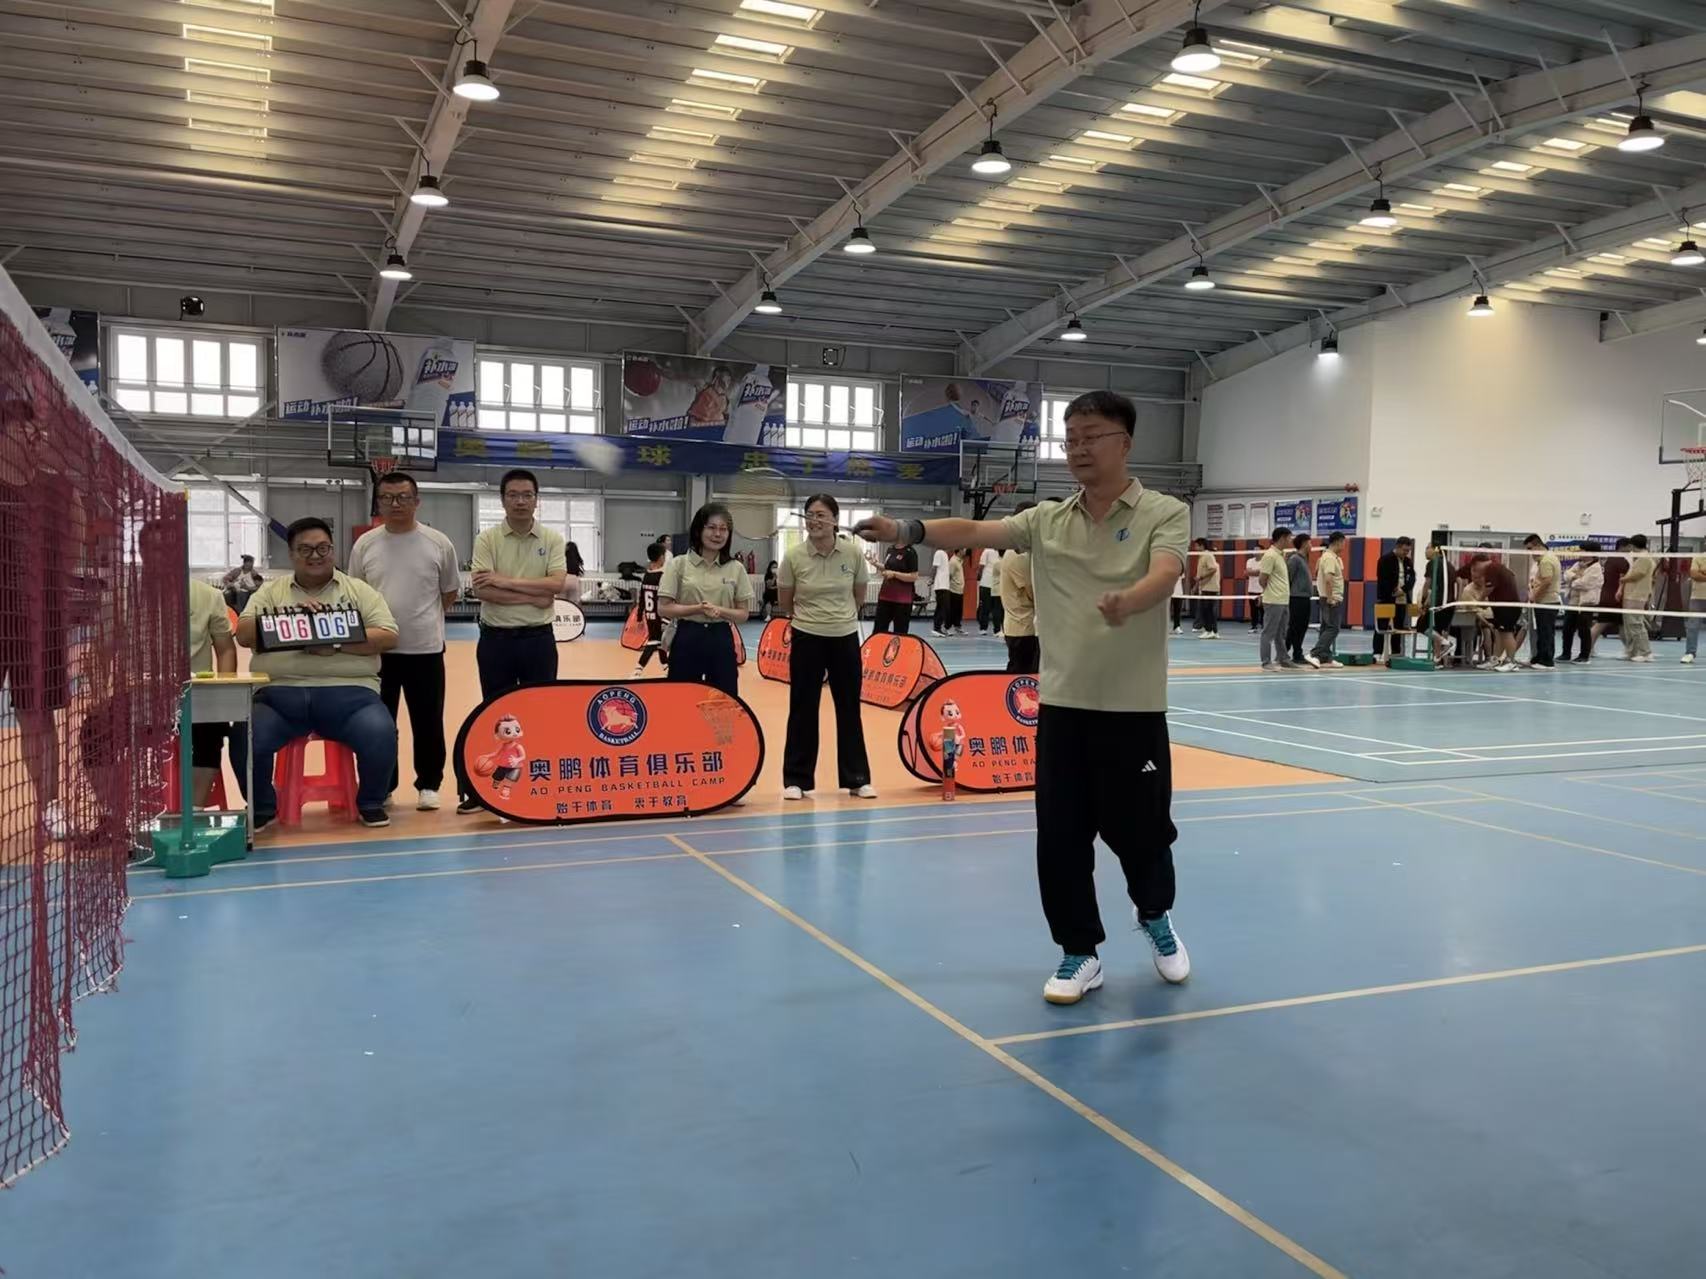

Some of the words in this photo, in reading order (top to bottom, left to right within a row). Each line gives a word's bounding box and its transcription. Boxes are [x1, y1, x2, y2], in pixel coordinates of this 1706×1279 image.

[644, 590, 655, 612] 6
[597, 690, 637, 706] AOPENG
[598, 731, 640, 745] BASKETBALL
[968, 735, 1036, 757] 奥鹏体
[529, 751, 724, 782] 奥鹏体育俱乐部
[530, 787, 549, 796] AO
[558, 784, 592, 794] PENG
[601, 780, 683, 792] BASKETBALL
[692, 777, 726, 786] CAMP
